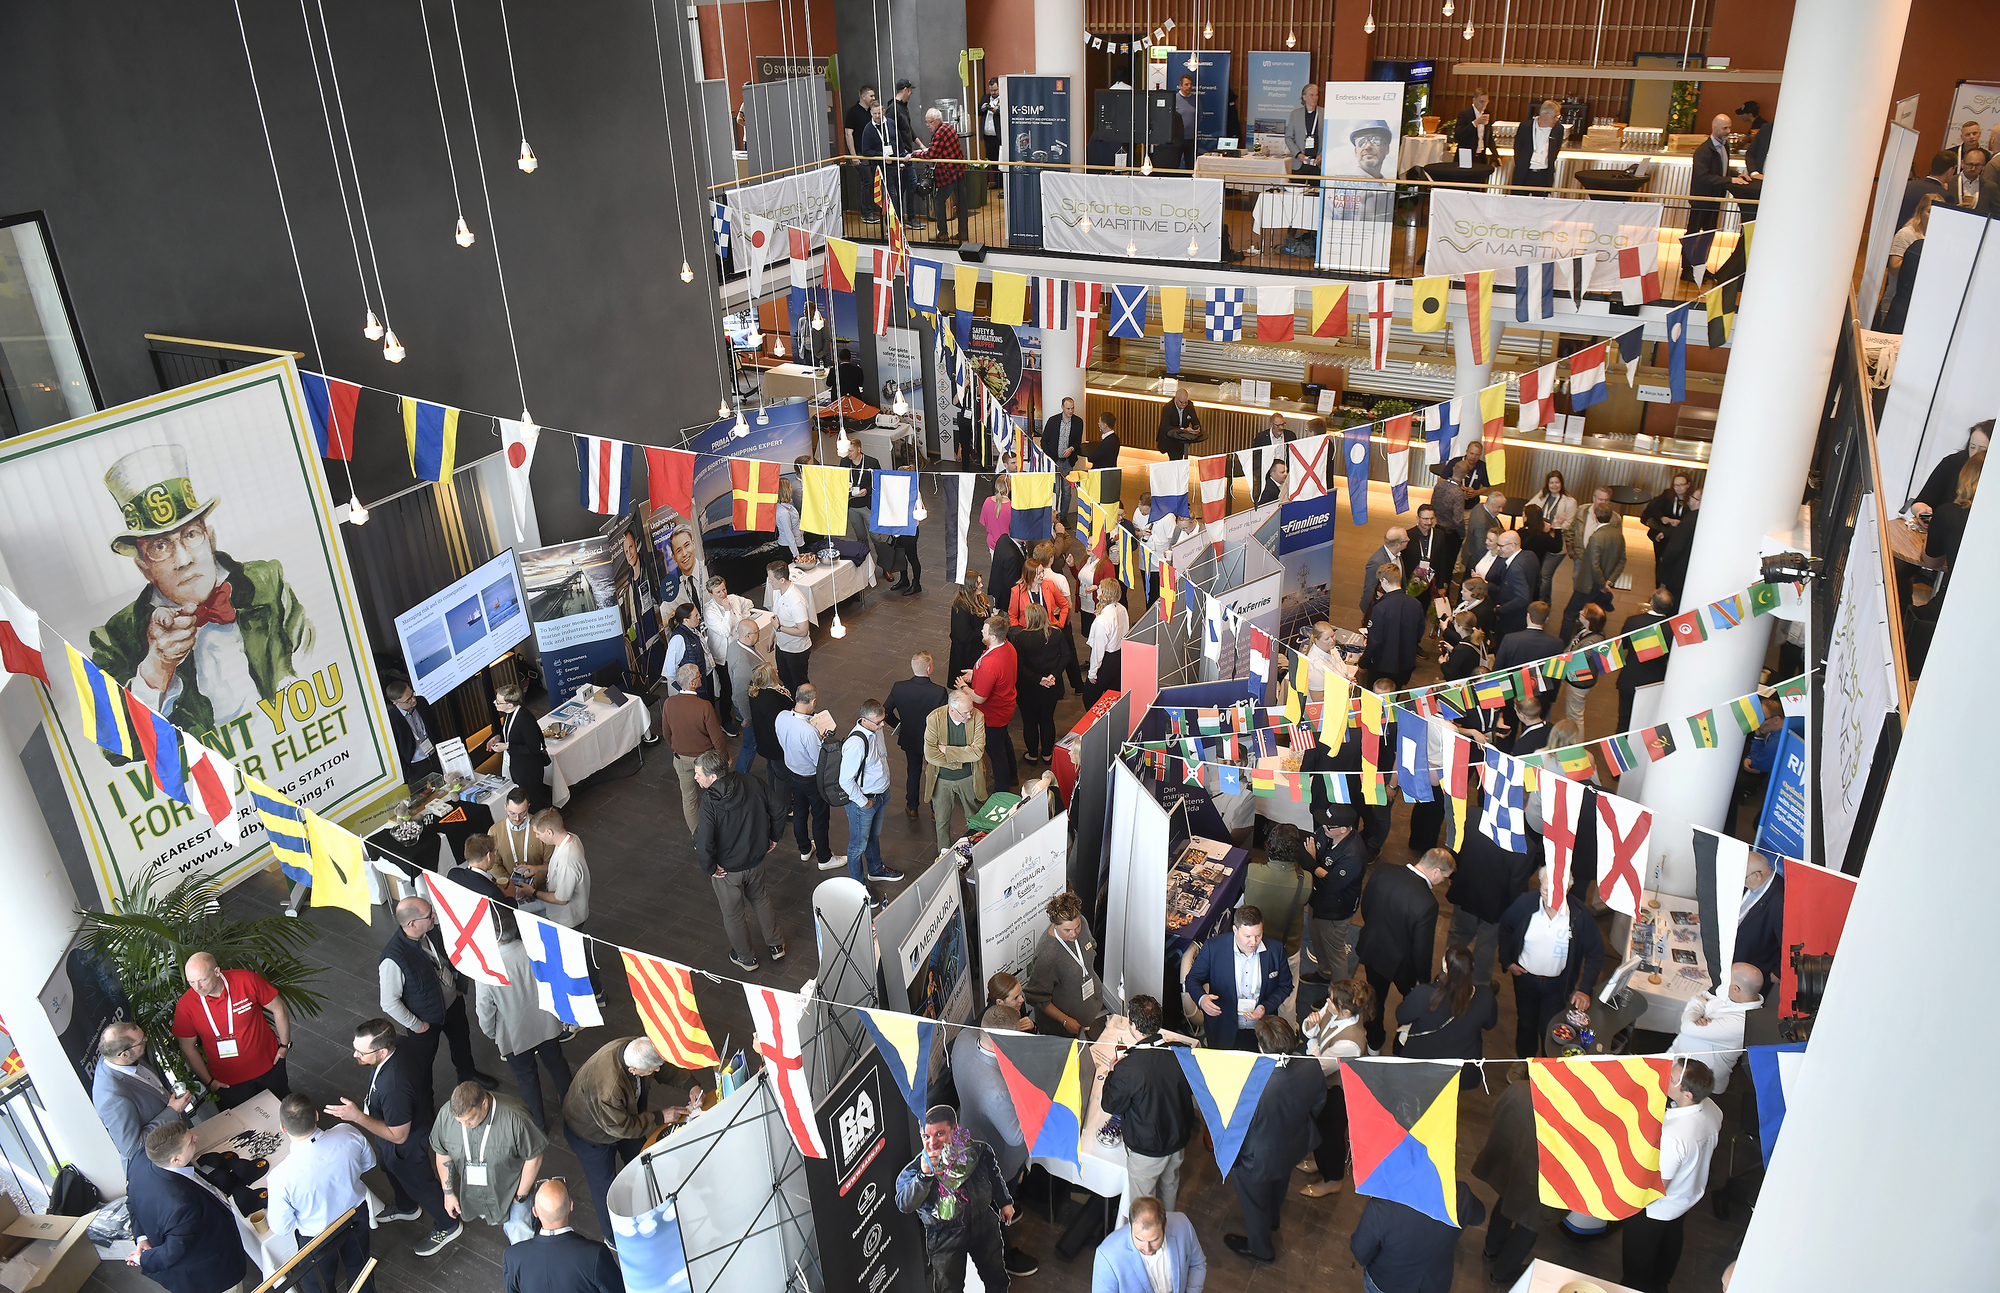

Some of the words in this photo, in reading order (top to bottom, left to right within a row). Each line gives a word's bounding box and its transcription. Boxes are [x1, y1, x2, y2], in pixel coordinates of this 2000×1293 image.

[1062, 198, 1152, 217] Sjöfartens
[1160, 203, 1200, 221] Dag
[1088, 216, 1169, 233] MARITIME
[1174, 221, 1212, 233] DAY
[1454, 220, 1569, 243] Sjöfartens
[1579, 229, 1629, 249] Dag
[758, 439, 784, 450] EXPERT
[1286, 512, 1331, 533] Finnlines
[1237, 597, 1271, 616] AxFerries
[541, 632, 561, 641] marine
[562, 625, 588, 637] industries
[596, 619, 618, 630] manage
[548, 625, 561, 634] help
[562, 622, 571, 630] our
[572, 618, 597, 627] members
[604, 613, 614, 621] the
[542, 639, 553, 647] risk
[574, 628, 613, 640] consequences
[563, 654, 588, 665] Shipowners
[564, 665, 581, 674] Energy
[107, 780, 129, 820] I
[257, 662, 344, 736] YOU
[129, 797, 196, 852] FOR
[271, 704, 348, 772] FLEET
[1163, 786, 1176, 794] Din
[152, 827, 213, 870] NEAREST
[298, 749, 350, 786] STATION
[1013, 865, 1046, 892] MERIAURA
[918, 894, 955, 954] MERIAURA
[852, 1208, 874, 1239] Devoted
[873, 1192, 886, 1212] crew
